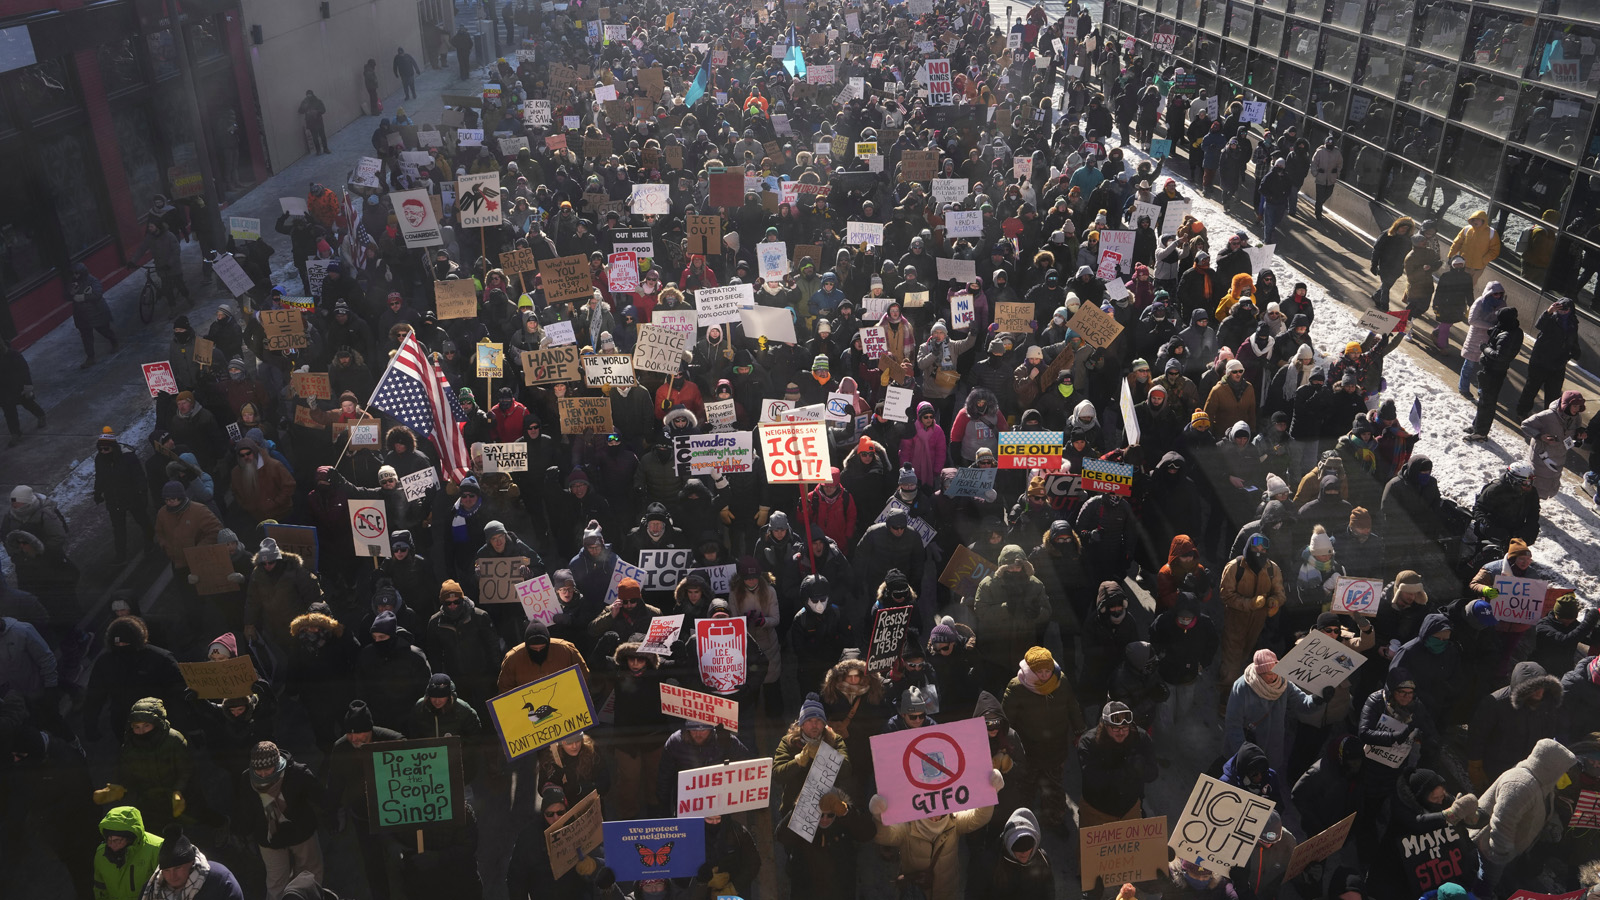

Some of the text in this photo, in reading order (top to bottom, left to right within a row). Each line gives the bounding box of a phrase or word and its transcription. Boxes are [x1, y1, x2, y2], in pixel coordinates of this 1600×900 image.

[1014, 53, 1025, 63] 84
[928, 62, 949, 75] NO
[929, 74, 950, 82] KINGS
[930, 81, 951, 94] NO
[931, 94, 951, 105] ICE
[525, 101, 551, 111] WE KNOW
[524, 116, 534, 125] WE
[458, 132, 473, 141] FUCK
[836, 134, 849, 144] ICE
[832, 147, 846, 156] NOW
[791, 183, 832, 195] MURDER
[587, 195, 605, 204] ICE
[464, 214, 499, 226] ON MN
[693, 216, 715, 225] ICE
[965, 211, 978, 219] ARE
[691, 226, 716, 236] OUT
[953, 225, 980, 233] AGITATORS
[404, 231, 440, 240] COWARDICE
[503, 249, 531, 263] STOP
[512, 265, 529, 273] US!
[545, 261, 564, 269] What
[555, 266, 576, 276] YOU
[547, 275, 563, 285] Have
[563, 274, 580, 282] Done
[438, 284, 454, 292] STOP
[564, 286, 590, 297] Find Out
[699, 286, 738, 296] OPERATION
[700, 293, 744, 304] METRO SIEGE:
[714, 301, 739, 310] SAFETY
[957, 300, 969, 311] MN
[265, 310, 297, 325] ICE
[662, 316, 677, 324] I'M
[1082, 315, 1098, 330] LESS
[866, 329, 878, 337] ICE
[1075, 319, 1107, 346] THUGS
[269, 334, 307, 350] GESTAPO
[640, 330, 685, 350] POLICE
[636, 344, 683, 363] STATE
[866, 344, 884, 352] FUCK
[527, 350, 575, 368] HANDS
[584, 356, 630, 366] THE WORLD
[534, 364, 568, 381] OFF
[603, 367, 613, 375] IS
[588, 375, 635, 386] WATCHING
[560, 398, 608, 409] THE SMALLEST
[567, 408, 598, 417] MEN WHO
[564, 416, 605, 427] EVER LIVED
[595, 425, 606, 433] ICE
[765, 427, 804, 437] NEIGHBORS
[483, 446, 504, 454] SAY
[767, 436, 818, 457] ICE
[1000, 445, 1062, 455] ICE OUT
[496, 459, 526, 468] NAME
[731, 457, 742, 467] by
[1012, 456, 1048, 467] MSP
[770, 459, 823, 478] OUT!
[402, 470, 433, 485] THIS IS
[958, 469, 986, 480] PROTECT
[1082, 471, 1131, 485] ICE OUT
[955, 479, 993, 490] PEOPLE NOT
[1092, 481, 1121, 492] MSP
[956, 488, 979, 496] POWER
[358, 513, 382, 531] ICE
[481, 560, 521, 578] ICE
[615, 561, 645, 583] ICE
[518, 576, 550, 597] ICE
[1496, 580, 1531, 597] ICE
[523, 588, 552, 606] OUT
[1345, 589, 1371, 606] ICE
[533, 598, 551, 613] OF
[1509, 597, 1542, 612] OUT
[877, 609, 909, 628] Resist
[715, 648, 730, 657] I.C.E.
[876, 638, 898, 656] 1938
[1303, 638, 1338, 660] PLOW
[711, 656, 734, 665] OUT OF
[703, 663, 743, 673] MINNEAPOLIS
[189, 673, 256, 688] MURDERING
[216, 686, 233, 695] US
[660, 684, 735, 710] SUPPORT
[682, 698, 715, 714] OUR
[661, 702, 739, 728] NEIGHBORS
[530, 710, 592, 746] TREAD ON ME
[382, 751, 438, 767] Do you
[390, 763, 433, 779] Hear
[820, 753, 843, 789] FREE
[407, 773, 424, 784] the
[685, 765, 769, 791] JUSTICE
[388, 773, 445, 802] People
[679, 786, 769, 814] NOT LIES
[912, 785, 970, 815] GTFO
[382, 795, 449, 825] Sing?
[1191, 781, 1272, 841] ICE
[645, 825, 679, 835] protect
[1086, 823, 1163, 845] SHAME ON YOU
[621, 832, 687, 842] our neighbors
[1182, 820, 1254, 860] OUT
[1401, 827, 1460, 859] MAKE
[1100, 841, 1141, 857] EMMER
[1429, 846, 1442, 859] IT
[1415, 848, 1463, 890] STOP
